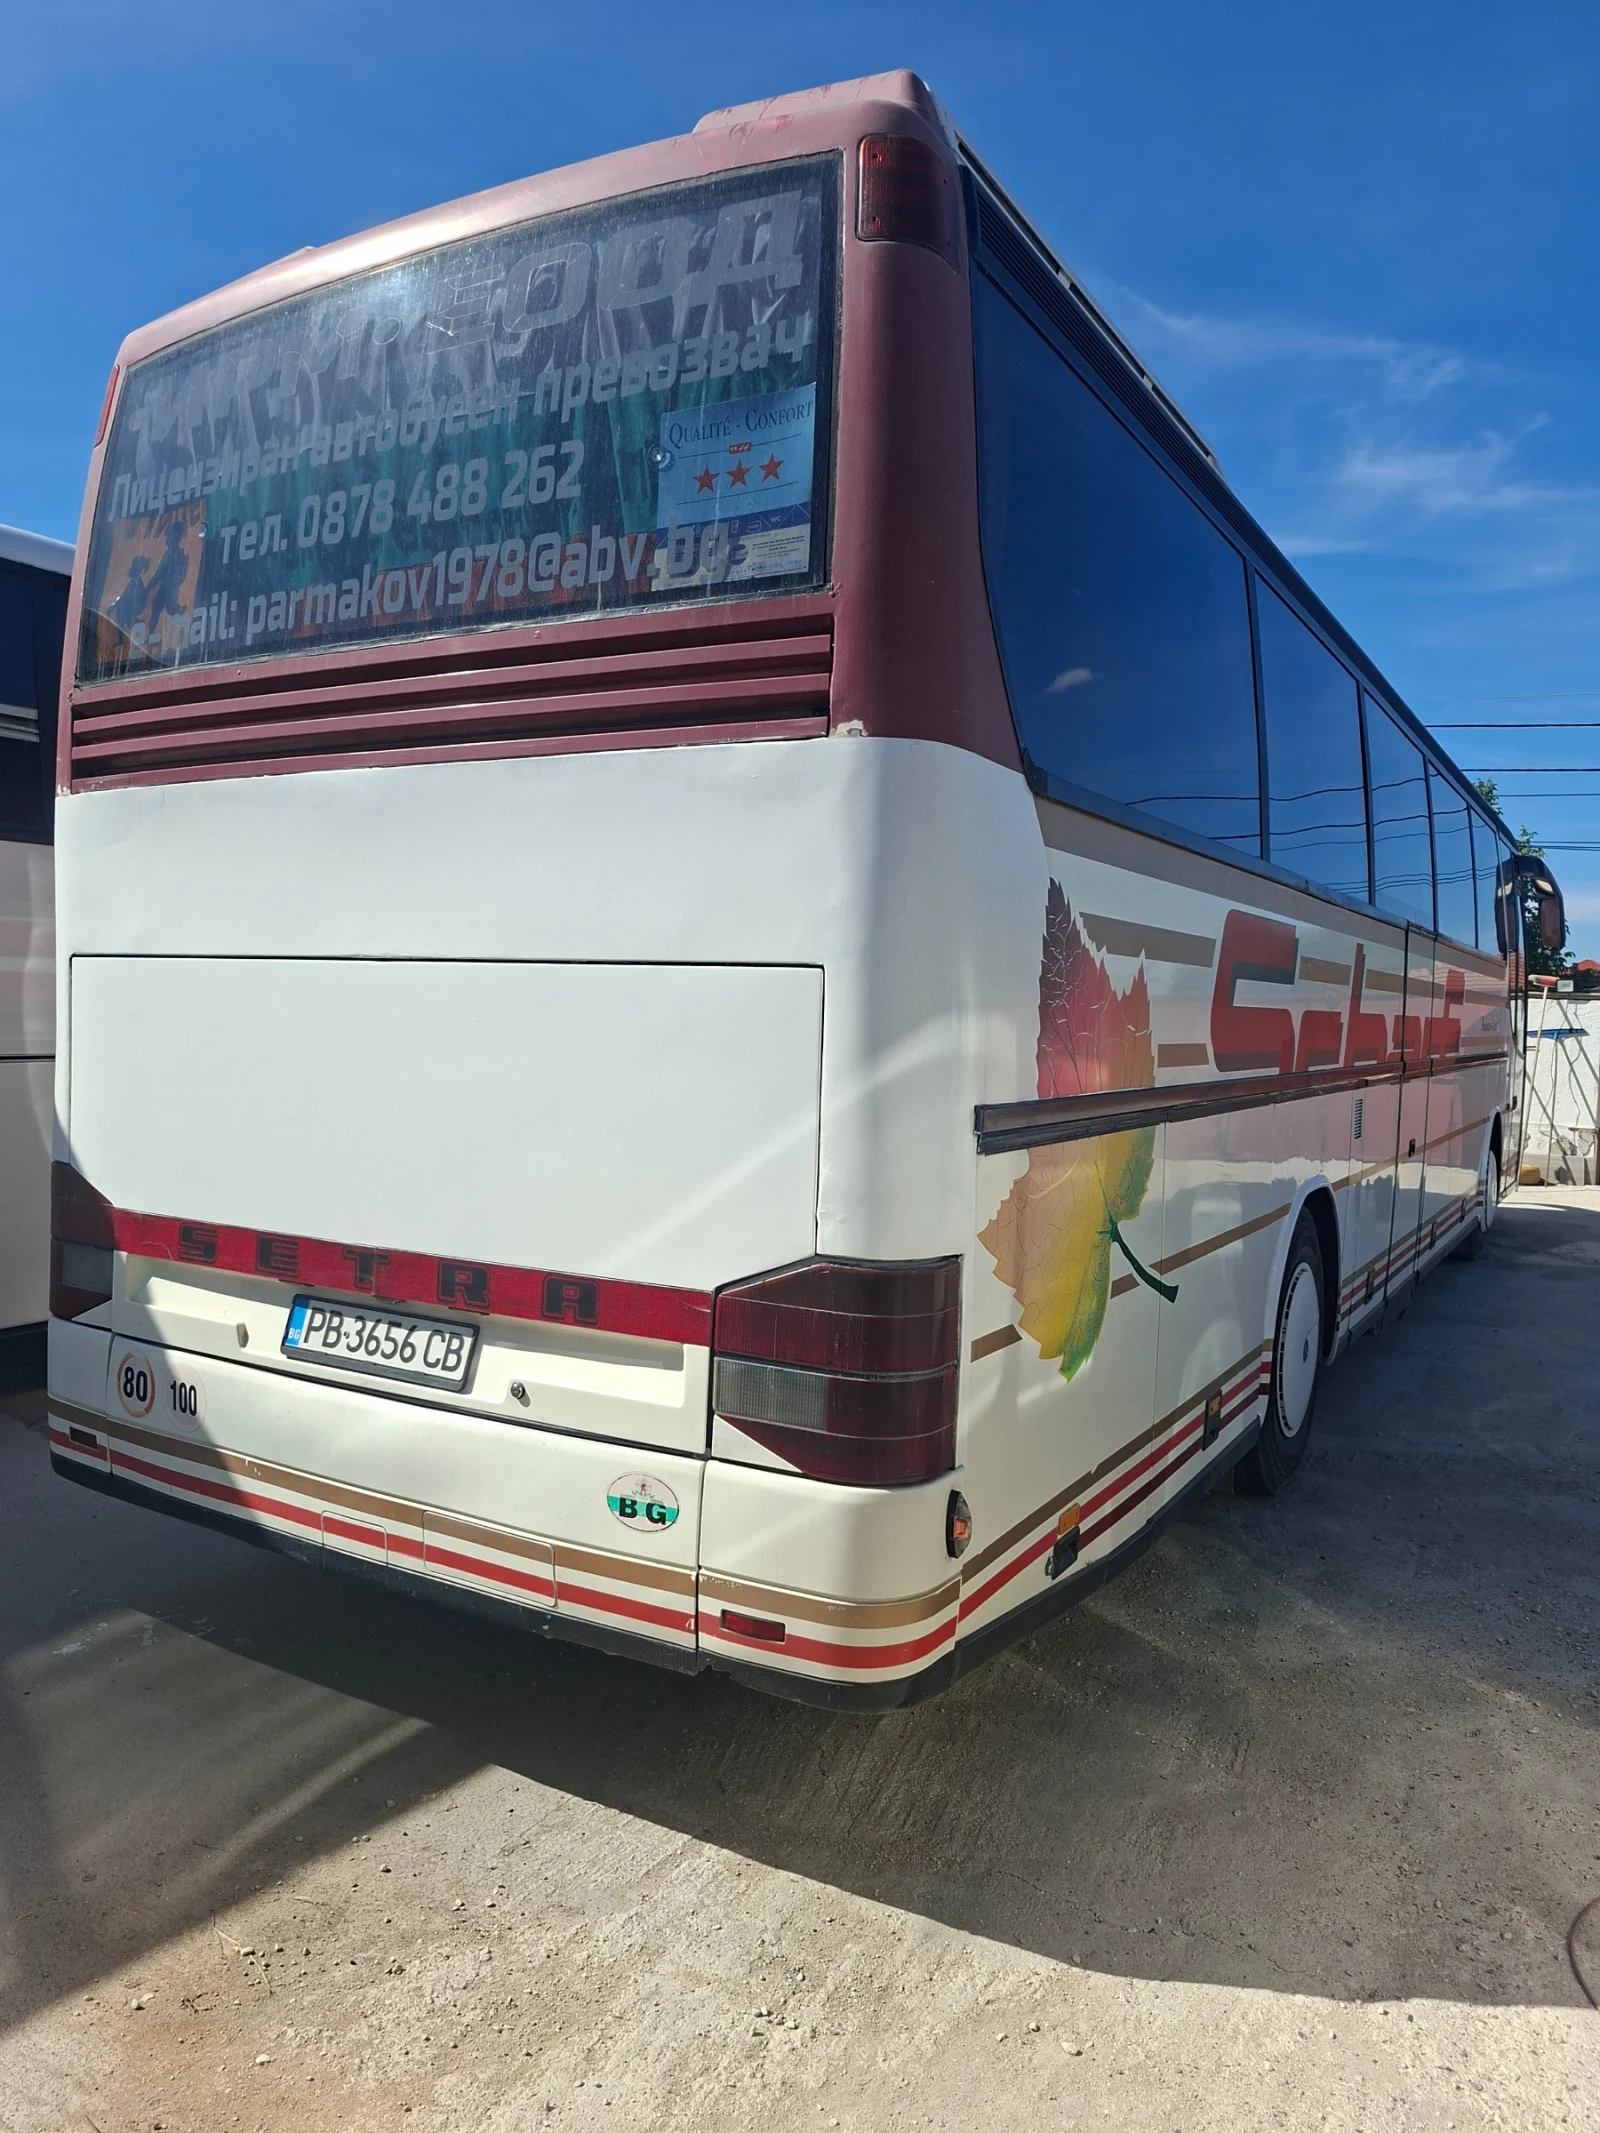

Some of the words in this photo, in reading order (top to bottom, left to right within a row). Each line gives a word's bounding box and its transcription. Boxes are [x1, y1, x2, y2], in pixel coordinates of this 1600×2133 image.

[427, 189, 803, 355] ЕООД
[108, 438, 299, 522] Лицензиран
[533, 313, 808, 424] превозвач
[221, 513, 288, 564] тел.
[297, 479, 396, 549] 0878
[407, 457, 489, 524] 488
[501, 440, 585, 509] 262
[770, 515, 782, 523] WC
[130, 591, 237, 660] e-mail:
[245, 516, 730, 646] parmakov1978@abv.bg
[178, 1221, 601, 1325] SETRA
[287, 1327, 301, 1340] BG
[123, 1366, 148, 1402] 80
[170, 1380, 197, 1416] 100
[619, 1494, 667, 1525] BG
